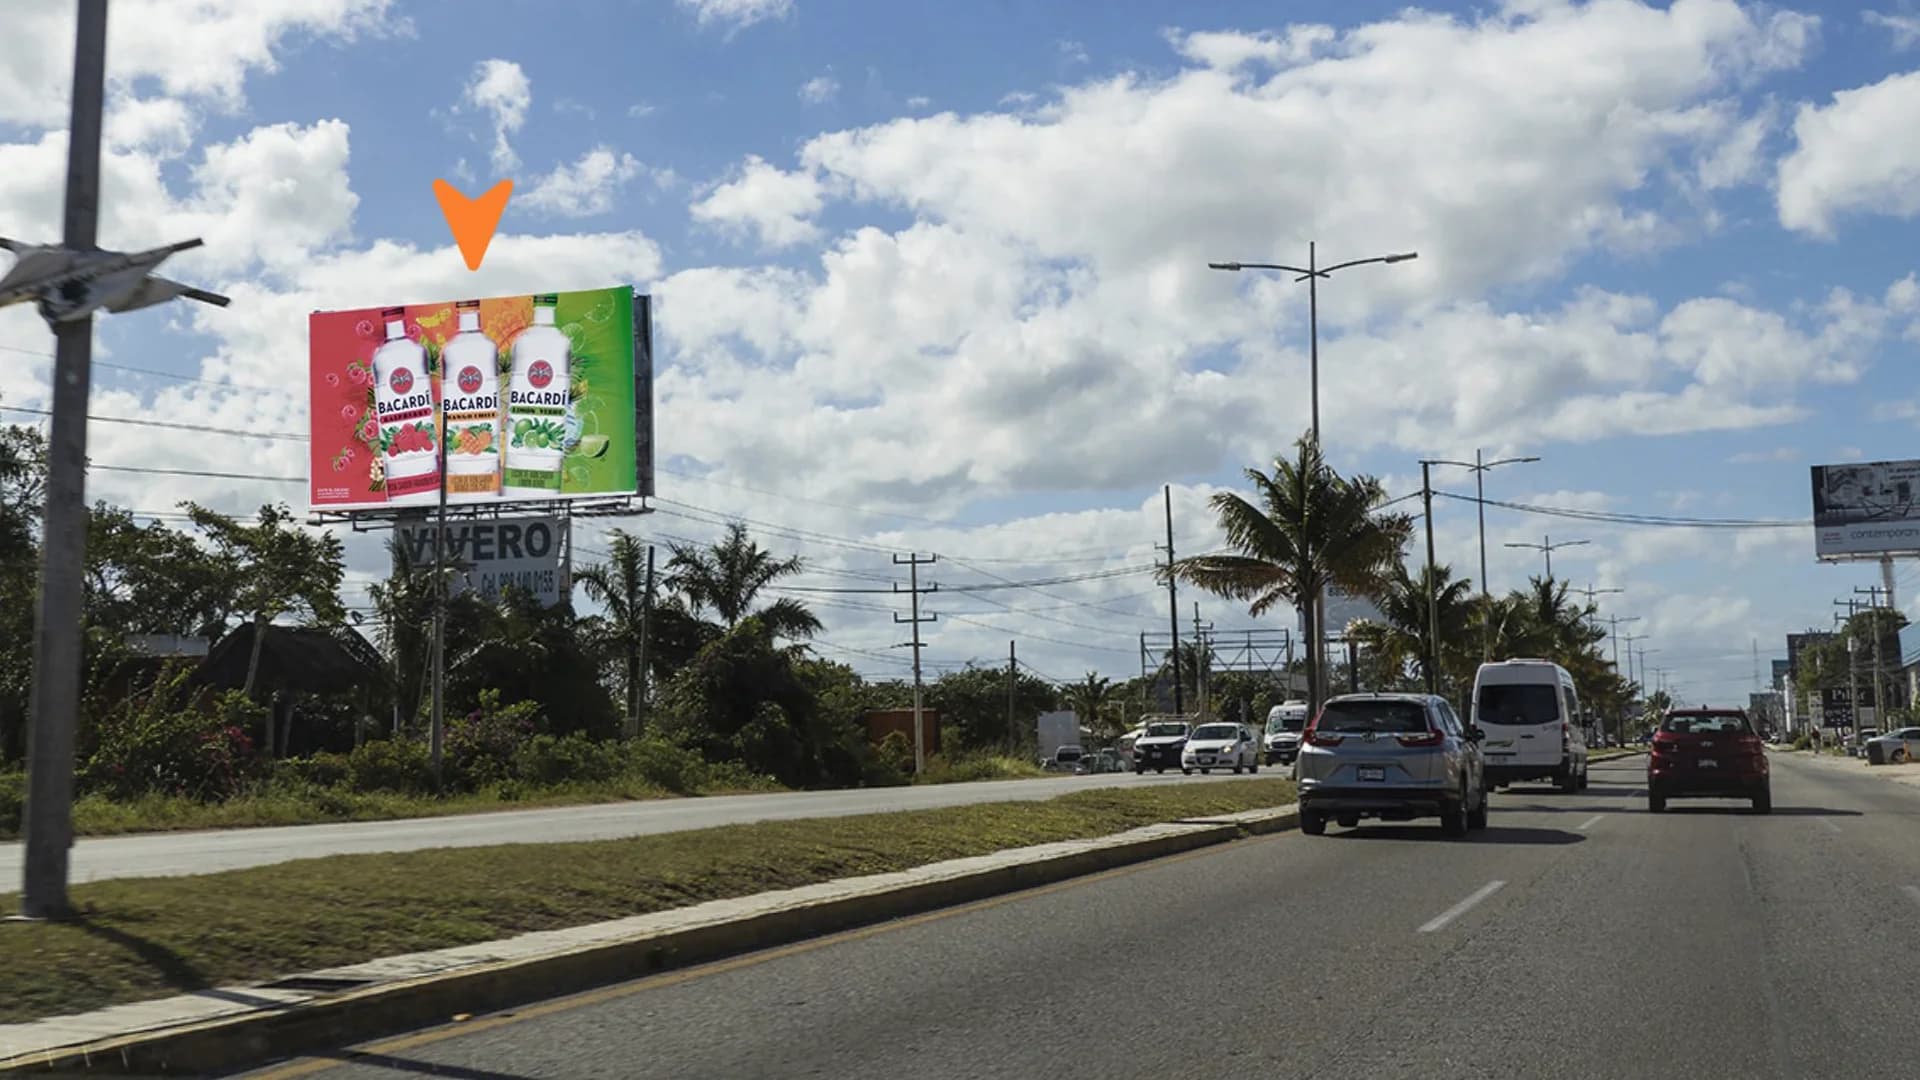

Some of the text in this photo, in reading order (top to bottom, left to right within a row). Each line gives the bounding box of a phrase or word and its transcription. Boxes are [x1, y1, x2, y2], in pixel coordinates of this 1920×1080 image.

[378, 390, 430, 414] BACARDÍ
[443, 391, 498, 411] BACARDÍ
[510, 389, 567, 405] BACARDÍ
[402, 522, 552, 562] VIVERO
